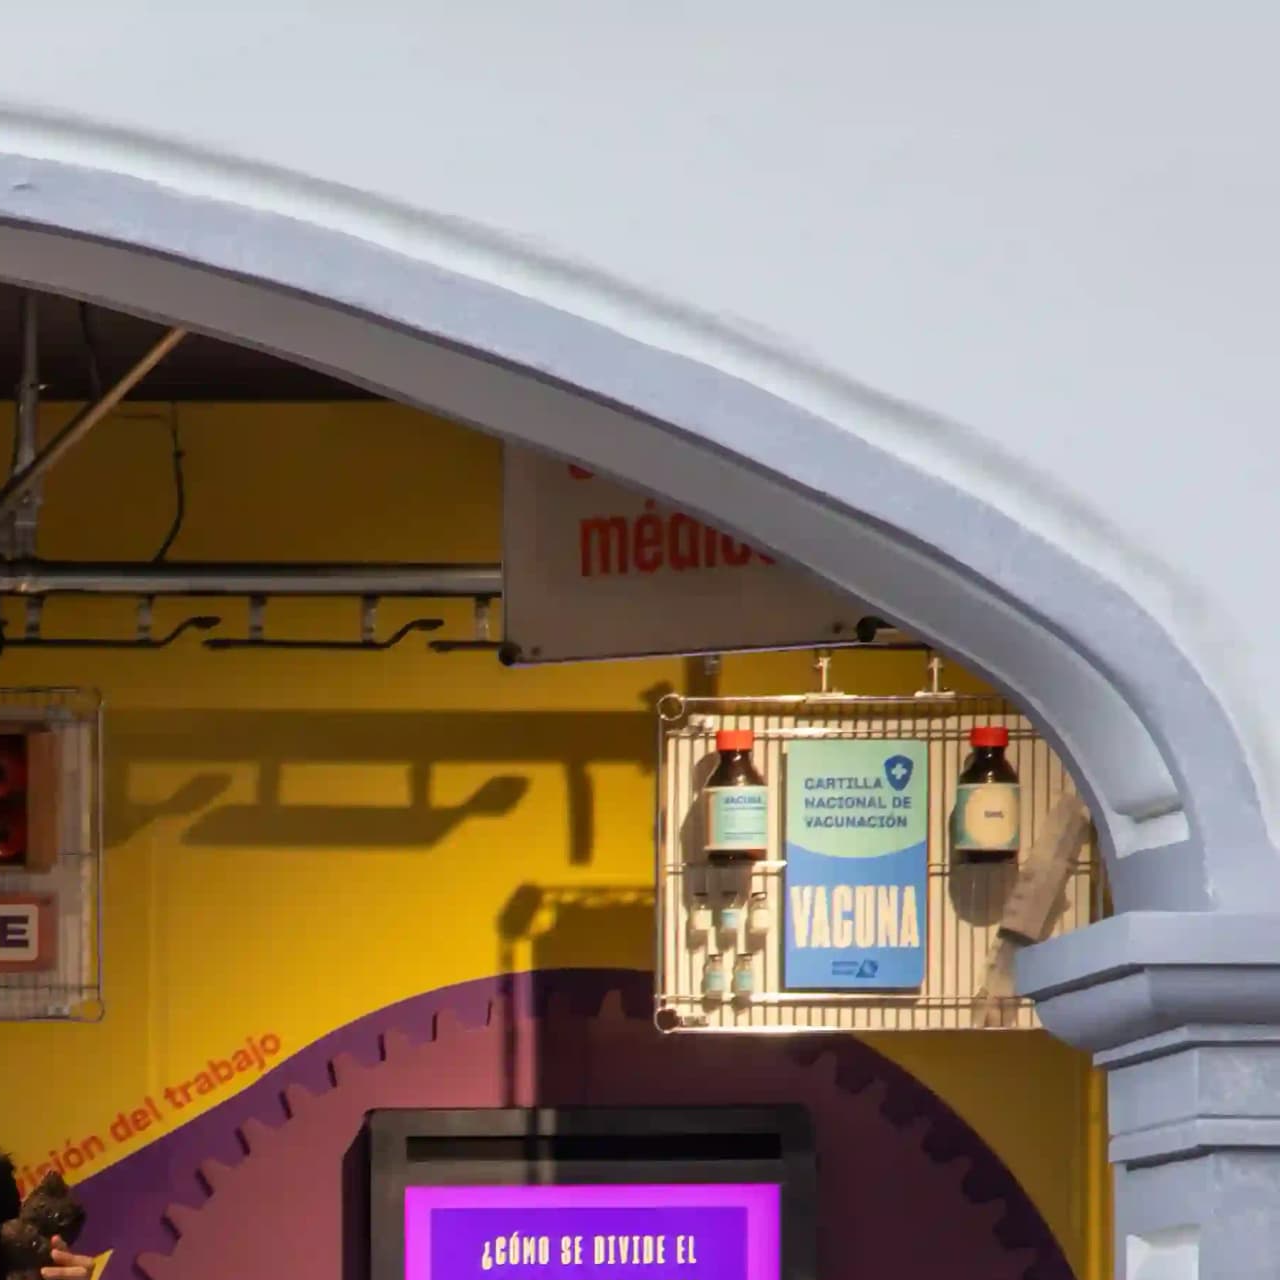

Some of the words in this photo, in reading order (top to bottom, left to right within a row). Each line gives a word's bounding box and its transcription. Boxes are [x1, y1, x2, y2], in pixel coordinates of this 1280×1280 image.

[803, 777, 883, 791] CARTILLA
[803, 796, 887, 810] NACIONAL
[891, 796, 912, 809] DE
[804, 813, 908, 829] VACUNACIÓN
[790, 884, 921, 949] VACUNA
[108, 1095, 163, 1143] del
[163, 1033, 282, 1110] trabajo
[481, 1231, 550, 1271] ¿CÓMO
[560, 1235, 584, 1265] SE
[593, 1234, 666, 1265] DIVIDE
[676, 1235, 698, 1264] EL
